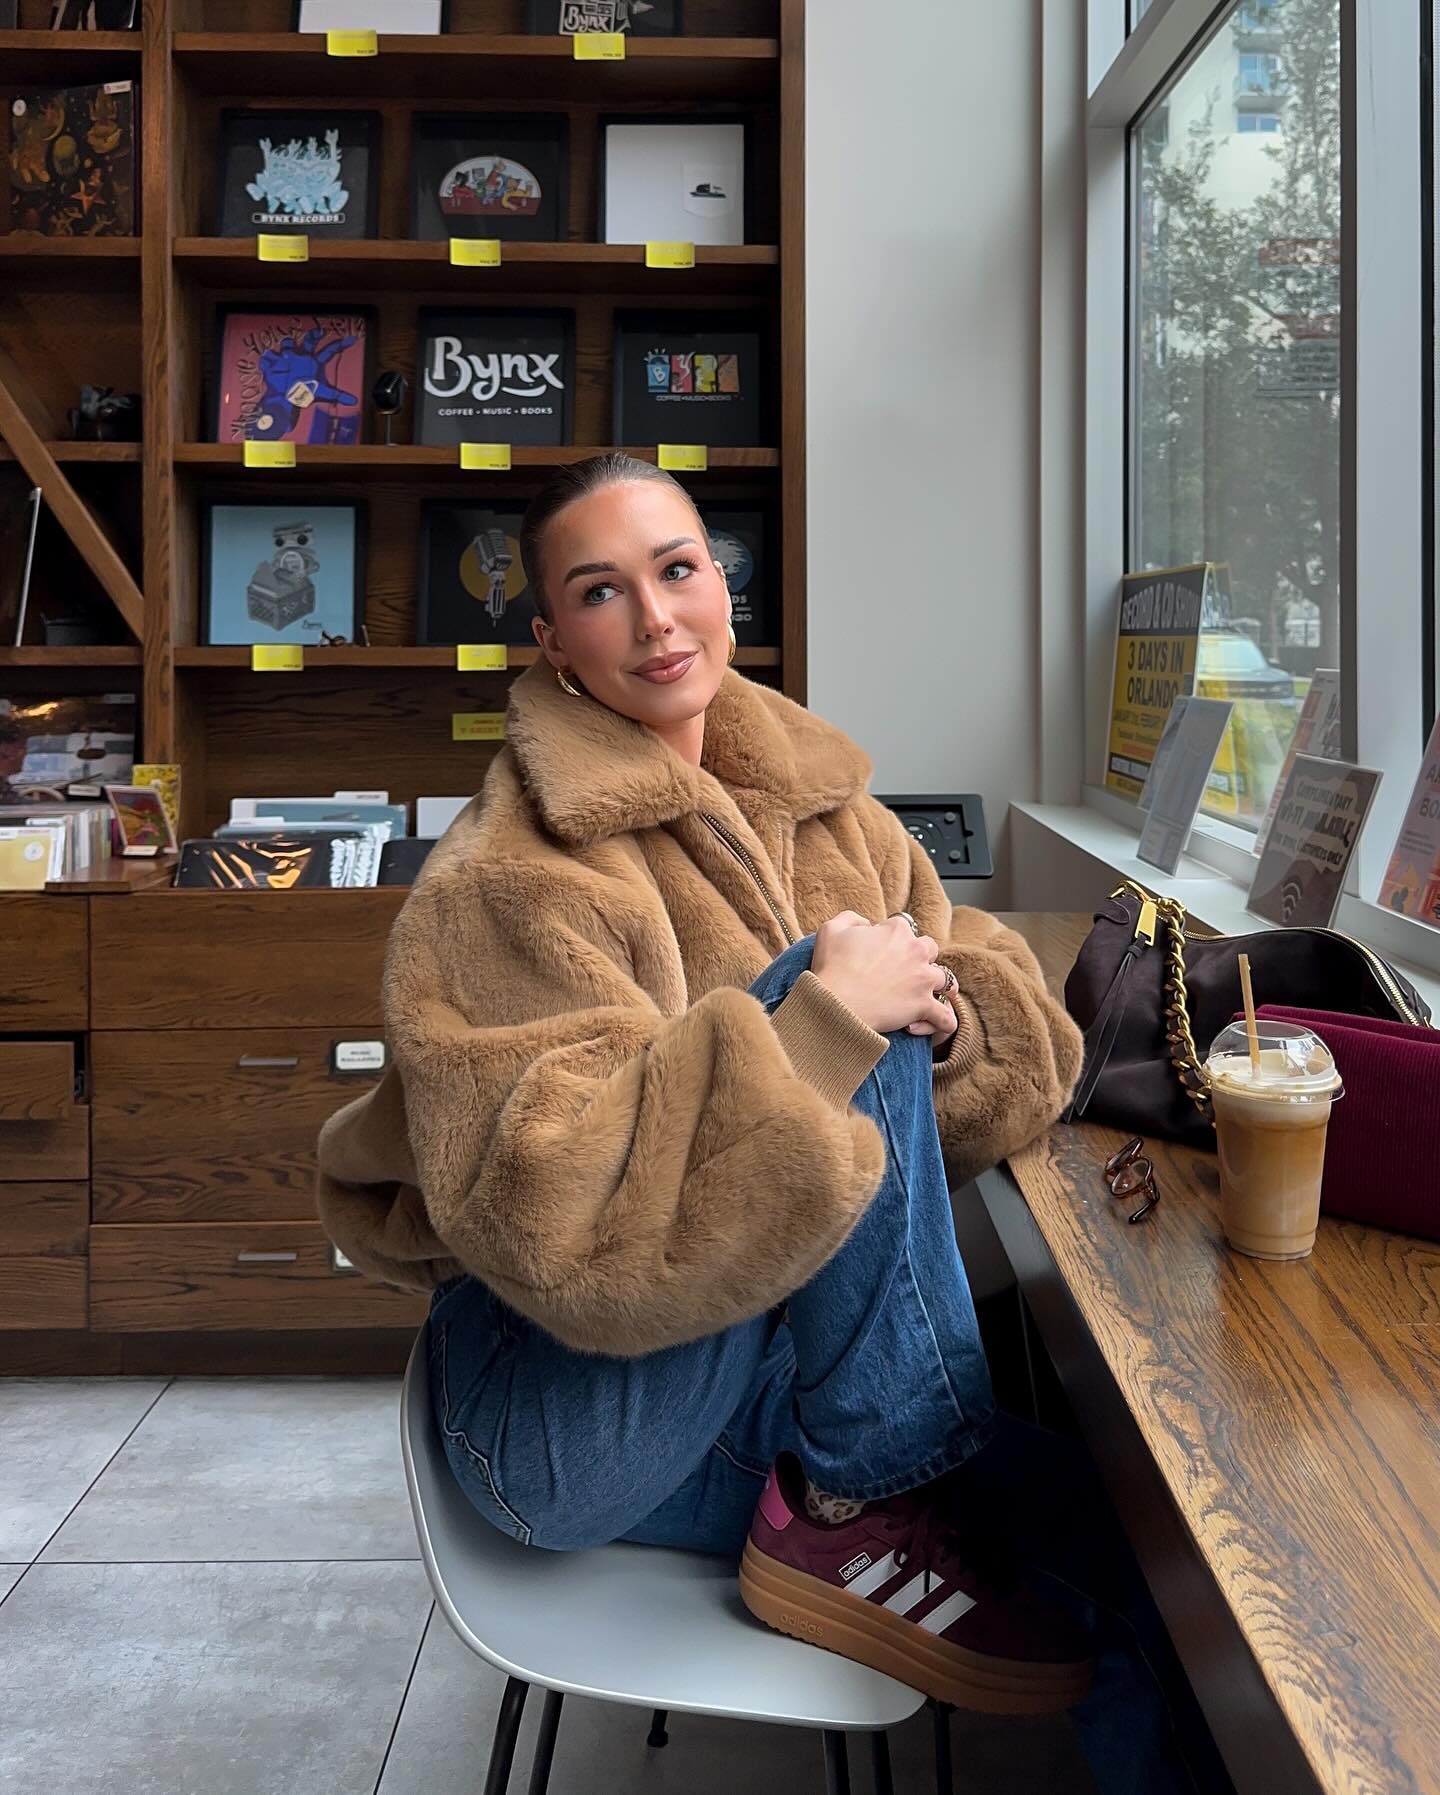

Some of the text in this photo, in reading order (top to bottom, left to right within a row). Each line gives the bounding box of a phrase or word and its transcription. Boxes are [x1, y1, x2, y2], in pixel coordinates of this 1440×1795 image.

[292, 214, 338, 223] RECORDS
[424, 336, 564, 401] Bynx
[438, 407, 553, 416] COFFEE MUSIC BOOKS
[1128, 641, 1184, 673] 3 DAYS IN
[1128, 676, 1178, 709] ORLANDO
[844, 1557, 868, 1577] adidas
[780, 1615, 824, 1637] adidas
